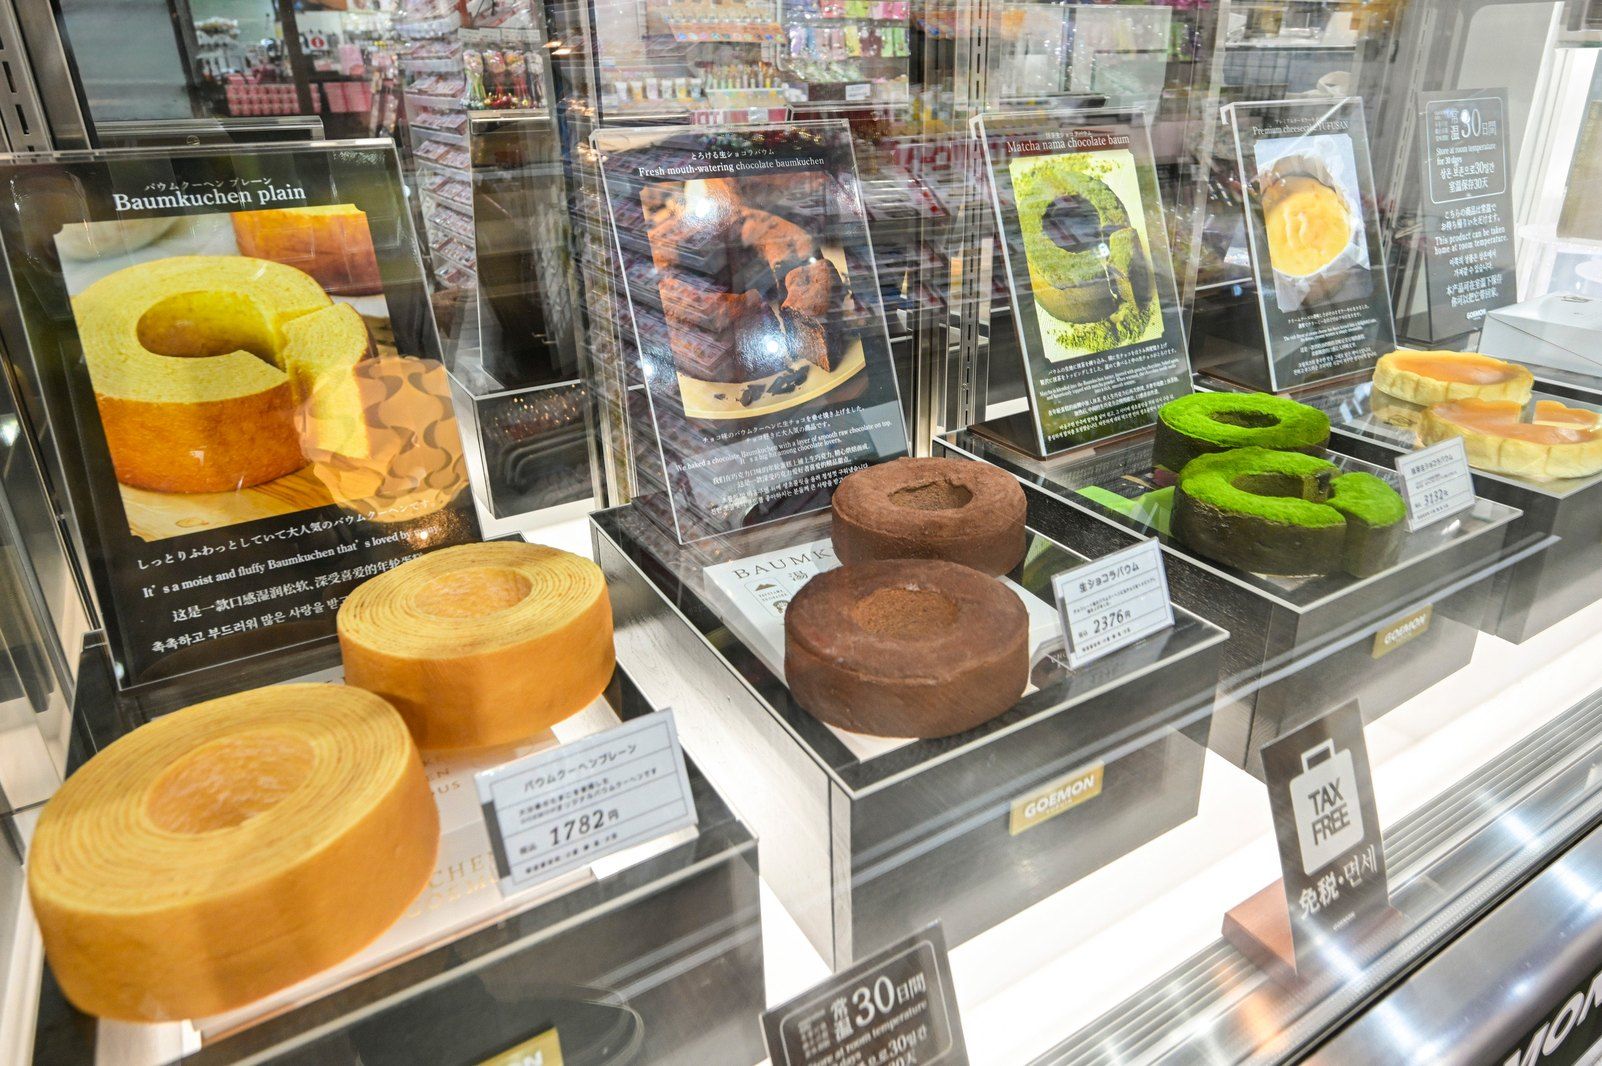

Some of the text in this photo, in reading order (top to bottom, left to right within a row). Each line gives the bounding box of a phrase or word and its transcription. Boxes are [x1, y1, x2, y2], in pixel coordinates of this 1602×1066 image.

[1007, 134, 1130, 153] Matcha nama chocolate baum
[1467, 143, 1497, 154] temperature
[638, 156, 825, 177] Fresh mouth-watering chocolate baumkuchen
[112, 183, 307, 213] Baumkuchen plain
[1435, 236, 1449, 246] This
[1449, 232, 1472, 245] product
[675, 463, 687, 472] We
[687, 458, 706, 470] baked
[711, 453, 741, 464] chocolate
[740, 444, 777, 458] Baumkuchen
[777, 440, 793, 450] with
[796, 437, 812, 448] layer
[811, 434, 818, 442] of
[817, 431, 839, 442] smooth
[838, 429, 849, 438] raw
[848, 423, 875, 435] chocolate
[796, 441, 824, 454] chocolate
[823, 437, 842, 448] lovers.
[171, 583, 181, 592] a
[180, 575, 214, 590] moist
[214, 568, 237, 582] and
[237, 562, 266, 578] fluffy
[266, 548, 336, 570] Baumkuchen
[371, 531, 399, 547] loved
[399, 529, 413, 543] by
[1078, 562, 1140, 593] 生ショコラバウム
[151, 631, 206, 653] 촉촉하고
[207, 617, 259, 640] 부드러워
[260, 610, 287, 627] 많은
[288, 601, 325, 618] 사랑을
[1093, 608, 1132, 634] 2376円
[524, 744, 637, 793] バウムクーヘンプレーン
[1024, 775, 1095, 818] GOEMON
[1308, 776, 1344, 816] TAX
[549, 808, 620, 847] 1782円
[1311, 801, 1351, 846] FREE
[845, 1032, 871, 1054] room
[871, 1000, 928, 1040] temperature
